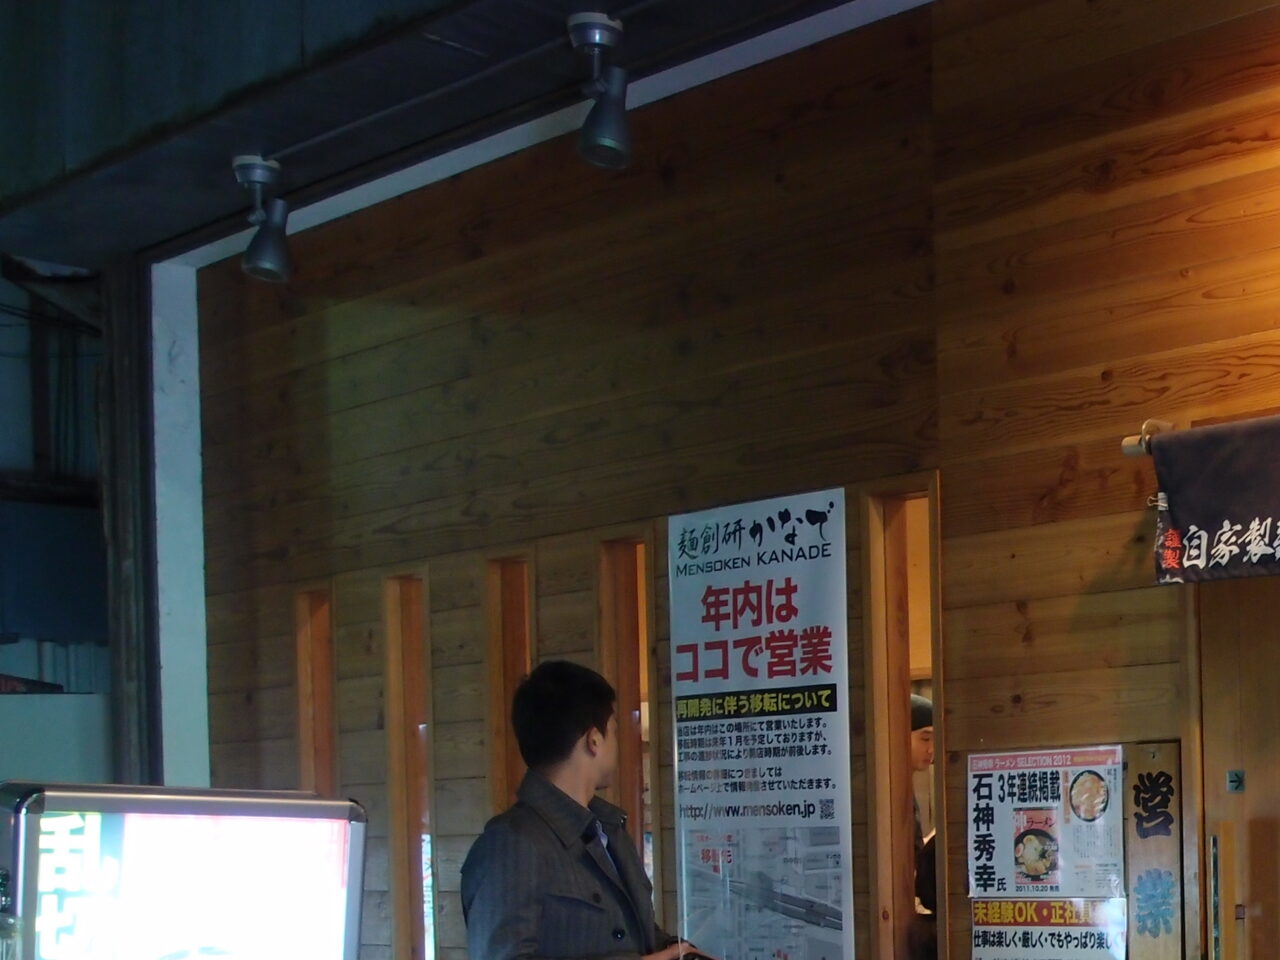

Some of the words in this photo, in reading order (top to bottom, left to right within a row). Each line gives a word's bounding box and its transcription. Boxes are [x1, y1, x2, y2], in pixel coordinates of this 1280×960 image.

[757, 542, 832, 565] KANADE
[700, 577, 798, 632] 年内は
[676, 625, 833, 683] ココで営業
[676, 689, 833, 719] 再開発に伴う移転について
[1053, 755, 1072, 766] 2012
[998, 771, 1061, 804] 3年連続掲載
[678, 799, 816, 821] http://www.mensoken.jp
